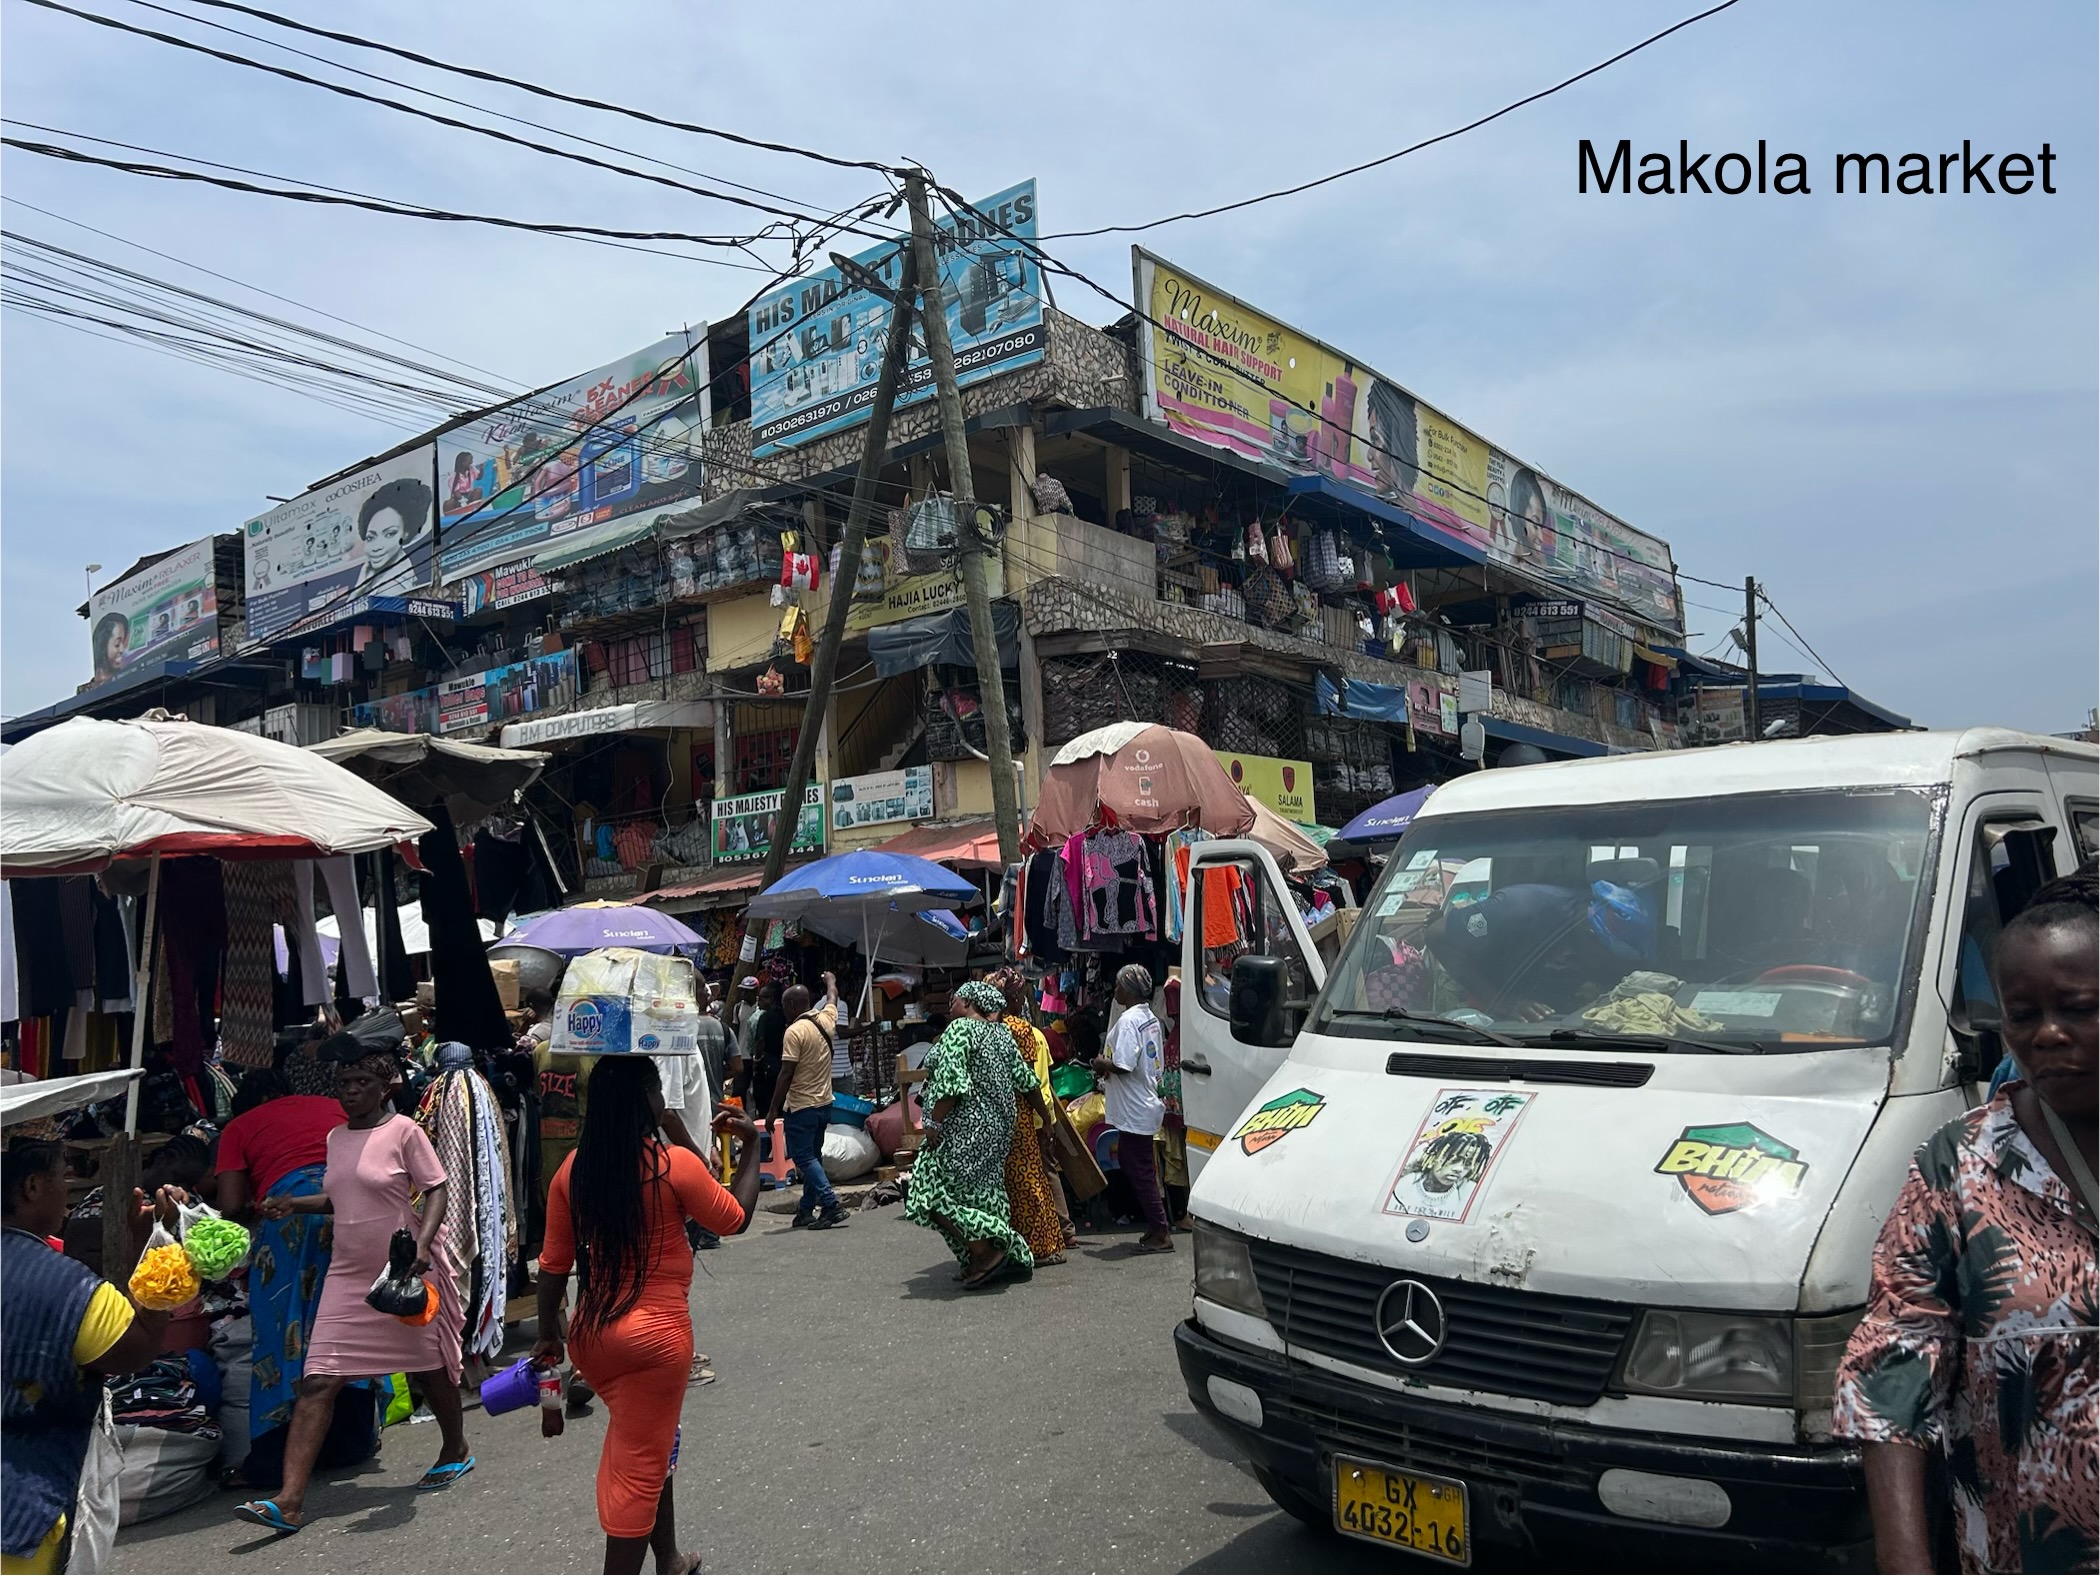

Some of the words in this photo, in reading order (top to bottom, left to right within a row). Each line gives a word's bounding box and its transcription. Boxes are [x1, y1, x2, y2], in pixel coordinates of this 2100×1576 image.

[756, 296, 795, 335] HIS
[937, 193, 1033, 258] HONES
[1164, 278, 1262, 355] Maxim
[1164, 313, 1210, 349] NATURAL
[1212, 337, 1239, 361] HAIR
[1240, 350, 1283, 383] SUPPORT
[586, 374, 615, 403] 5X
[767, 401, 841, 437] 0302631970
[953, 332, 1035, 370] 262107080
[1164, 358, 1223, 394] LEAVE-IN
[1163, 373, 1250, 420] CONDITIONER
[159, 552, 201, 579] RELAXER
[408, 602, 427, 615] 0244
[428, 606, 441, 617] 613
[888, 591, 920, 610] HAJIA
[922, 581, 960, 601] LUCKY
[1513, 605, 1538, 617] 0244
[1540, 605, 1559, 616] 613
[1559, 604, 1579, 616] 551
[545, 711, 617, 738] COMPUTERS
[1124, 762, 1164, 772] vodafone
[717, 800, 733, 818] HIS
[735, 793, 778, 815] MAJESTY
[1134, 798, 1160, 808] cash
[1278, 794, 1304, 808] SALAMA
[567, 1012, 604, 1035] Happy
[638, 1038, 660, 1049] Happy
[539, 1071, 578, 1099] SIZE
[1384, 1475, 1418, 1511] GX
[1443, 1487, 1461, 1505] GH
[1343, 1499, 1462, 1556] 4032-16
